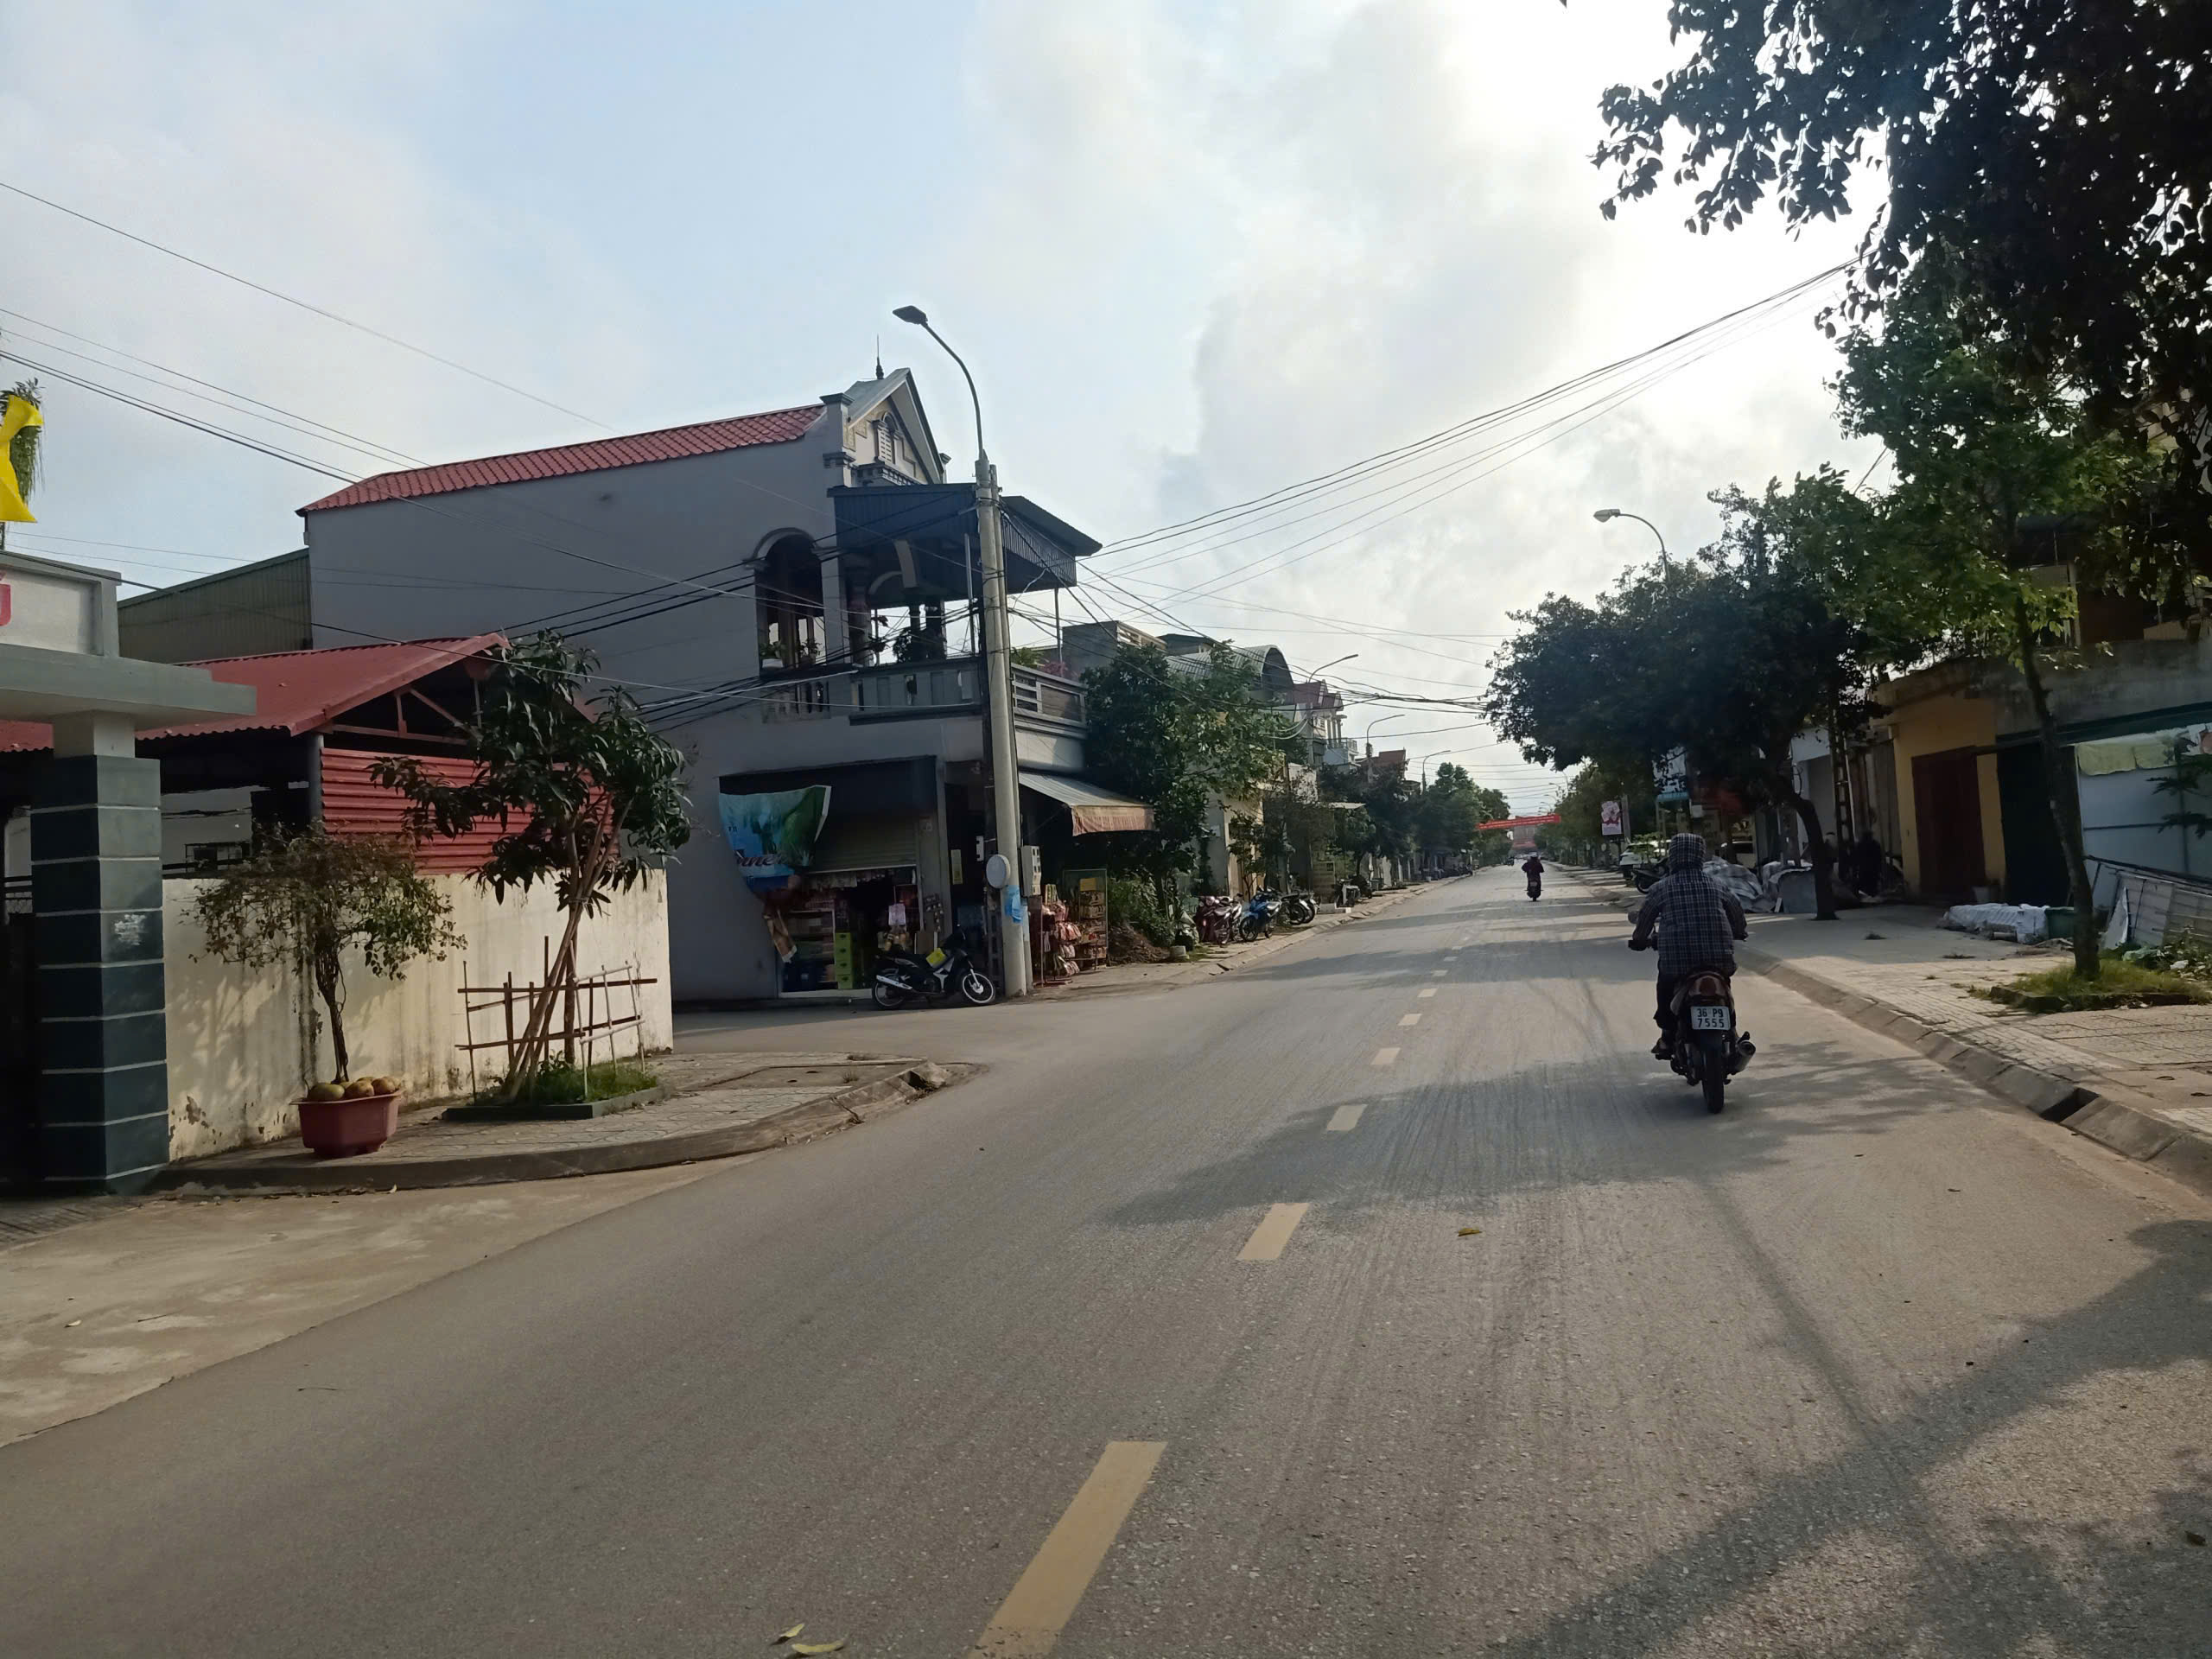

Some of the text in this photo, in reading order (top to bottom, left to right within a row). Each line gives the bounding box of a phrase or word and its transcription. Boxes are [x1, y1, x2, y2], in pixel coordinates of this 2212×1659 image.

[1697, 1008, 1724, 1017] 36 P9
[1697, 1019, 1725, 1027] 7555
